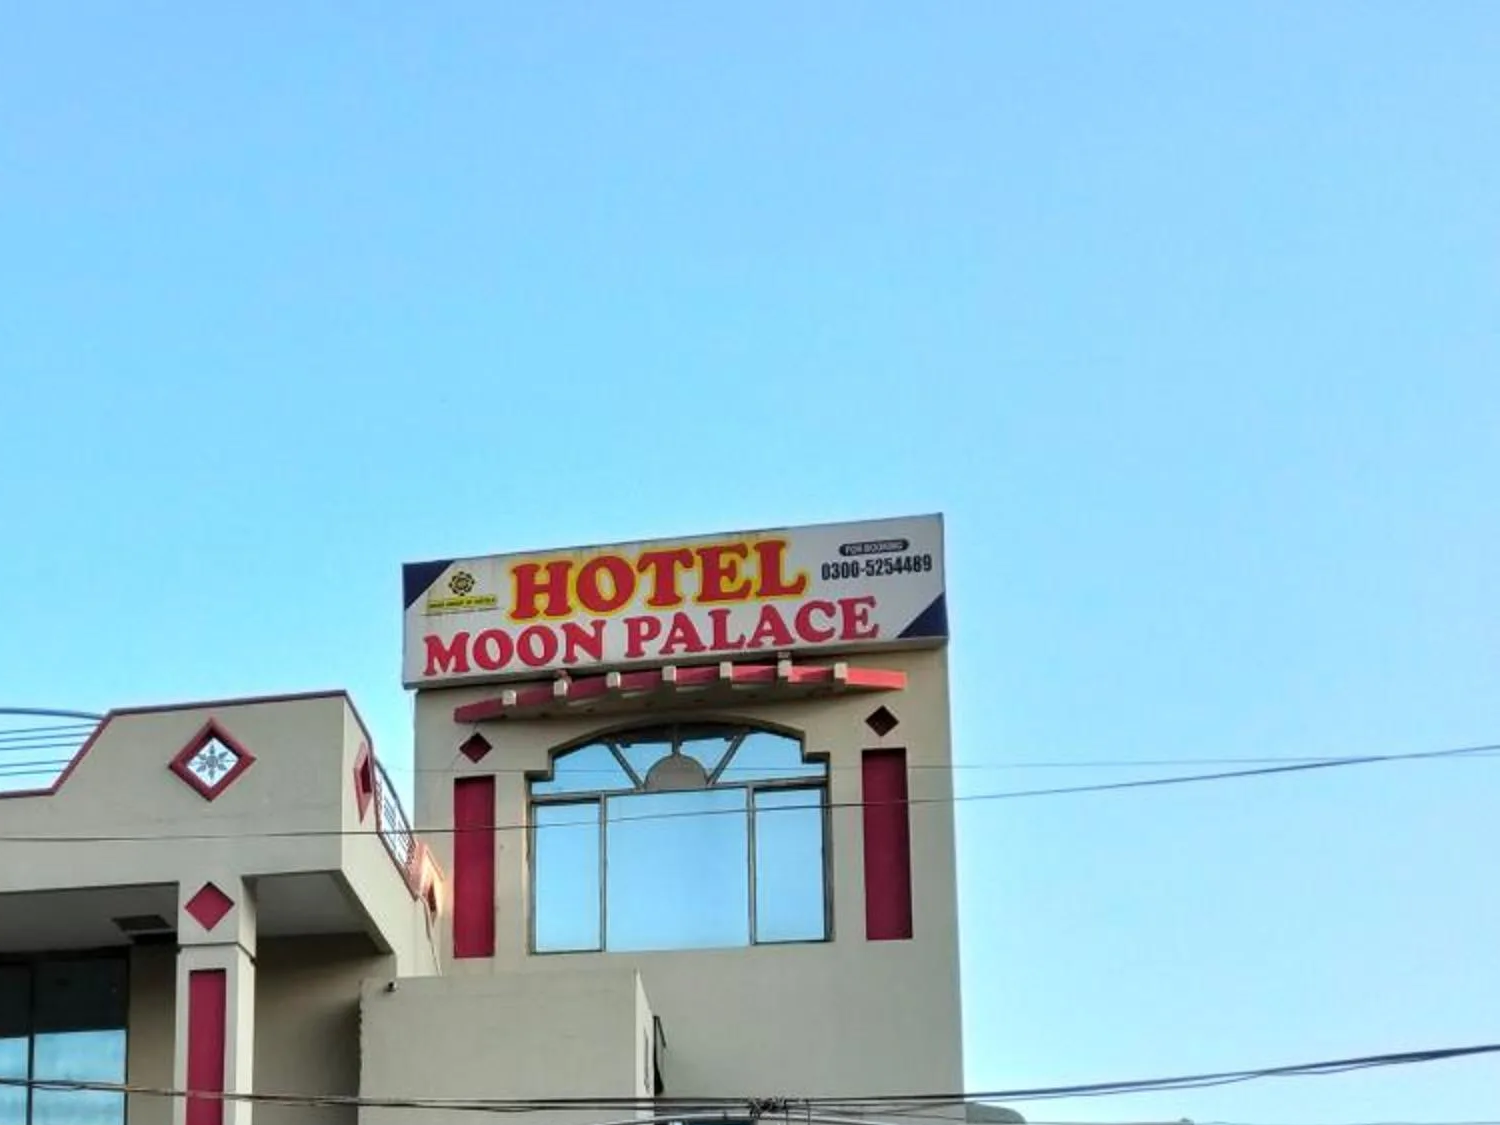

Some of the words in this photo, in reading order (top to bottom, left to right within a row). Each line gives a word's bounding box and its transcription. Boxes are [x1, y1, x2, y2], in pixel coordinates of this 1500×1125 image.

[509, 539, 807, 620] HOTEL
[821, 553, 933, 581] 0300-5254489
[423, 618, 608, 677] MOON
[623, 595, 880, 659] PALACE
